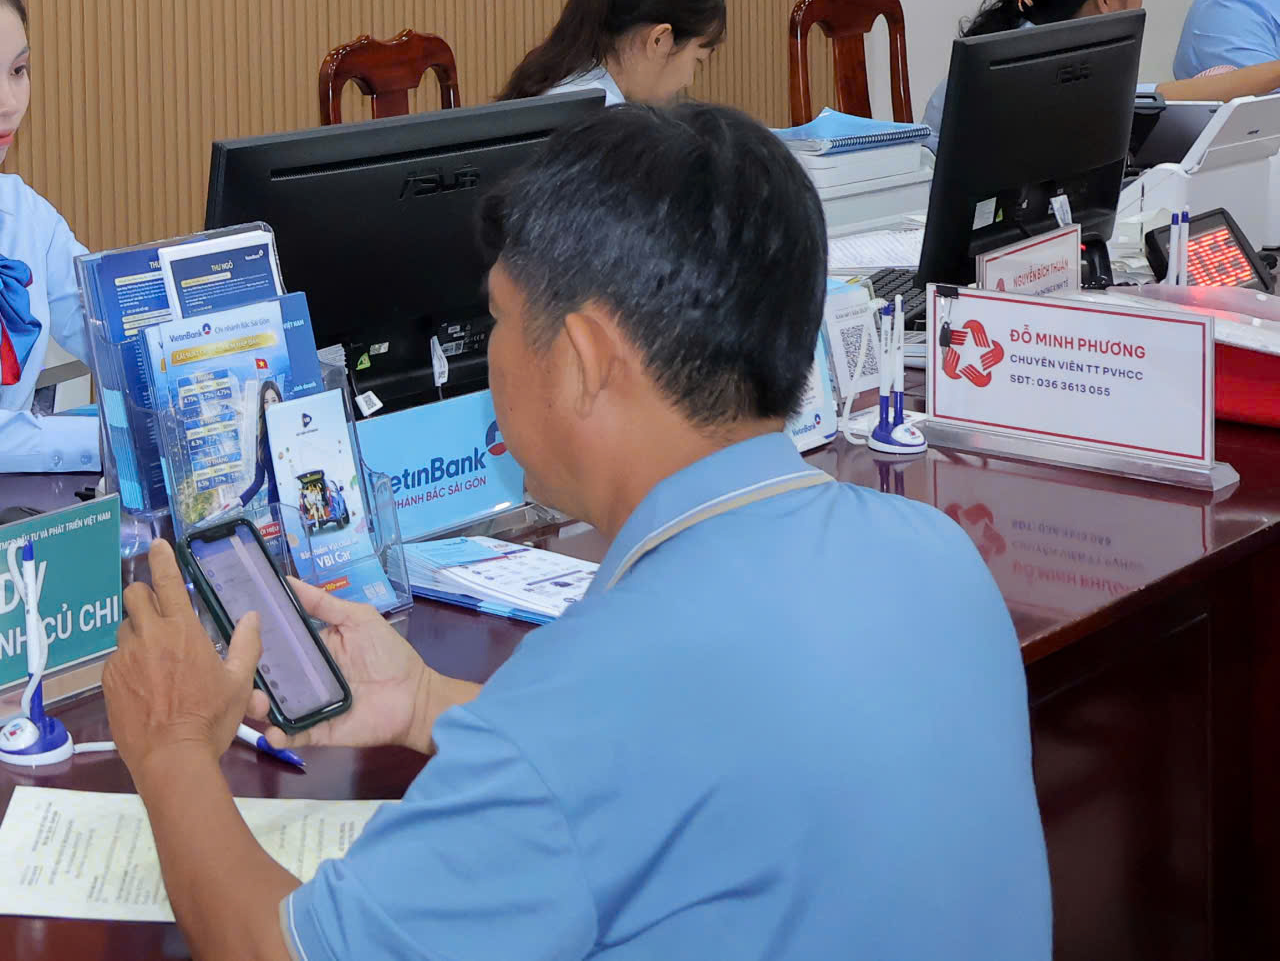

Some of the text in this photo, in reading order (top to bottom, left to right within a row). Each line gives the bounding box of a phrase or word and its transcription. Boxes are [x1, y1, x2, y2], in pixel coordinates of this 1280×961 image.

[397, 167, 481, 201] ASUS
[170, 328, 203, 343] VietinBank
[1010, 324, 1146, 359] ĐỖ MINH PHƯƠNG
[1010, 354, 1144, 381] CHUYÊN VIÊN TT PVHCC
[1010, 374, 1111, 397] SĐT: 036 3613 055
[464, 475, 487, 491] GÒN
[48, 524, 65, 537] PHÁT
[65, 518, 83, 533] TRIỂN
[83, 514, 97, 527] VIỆT
[97, 510, 112, 522] NAM
[316, 550, 352, 568] VBI Car
[41, 602, 72, 645] CỦ
[79, 595, 119, 632] CHI
